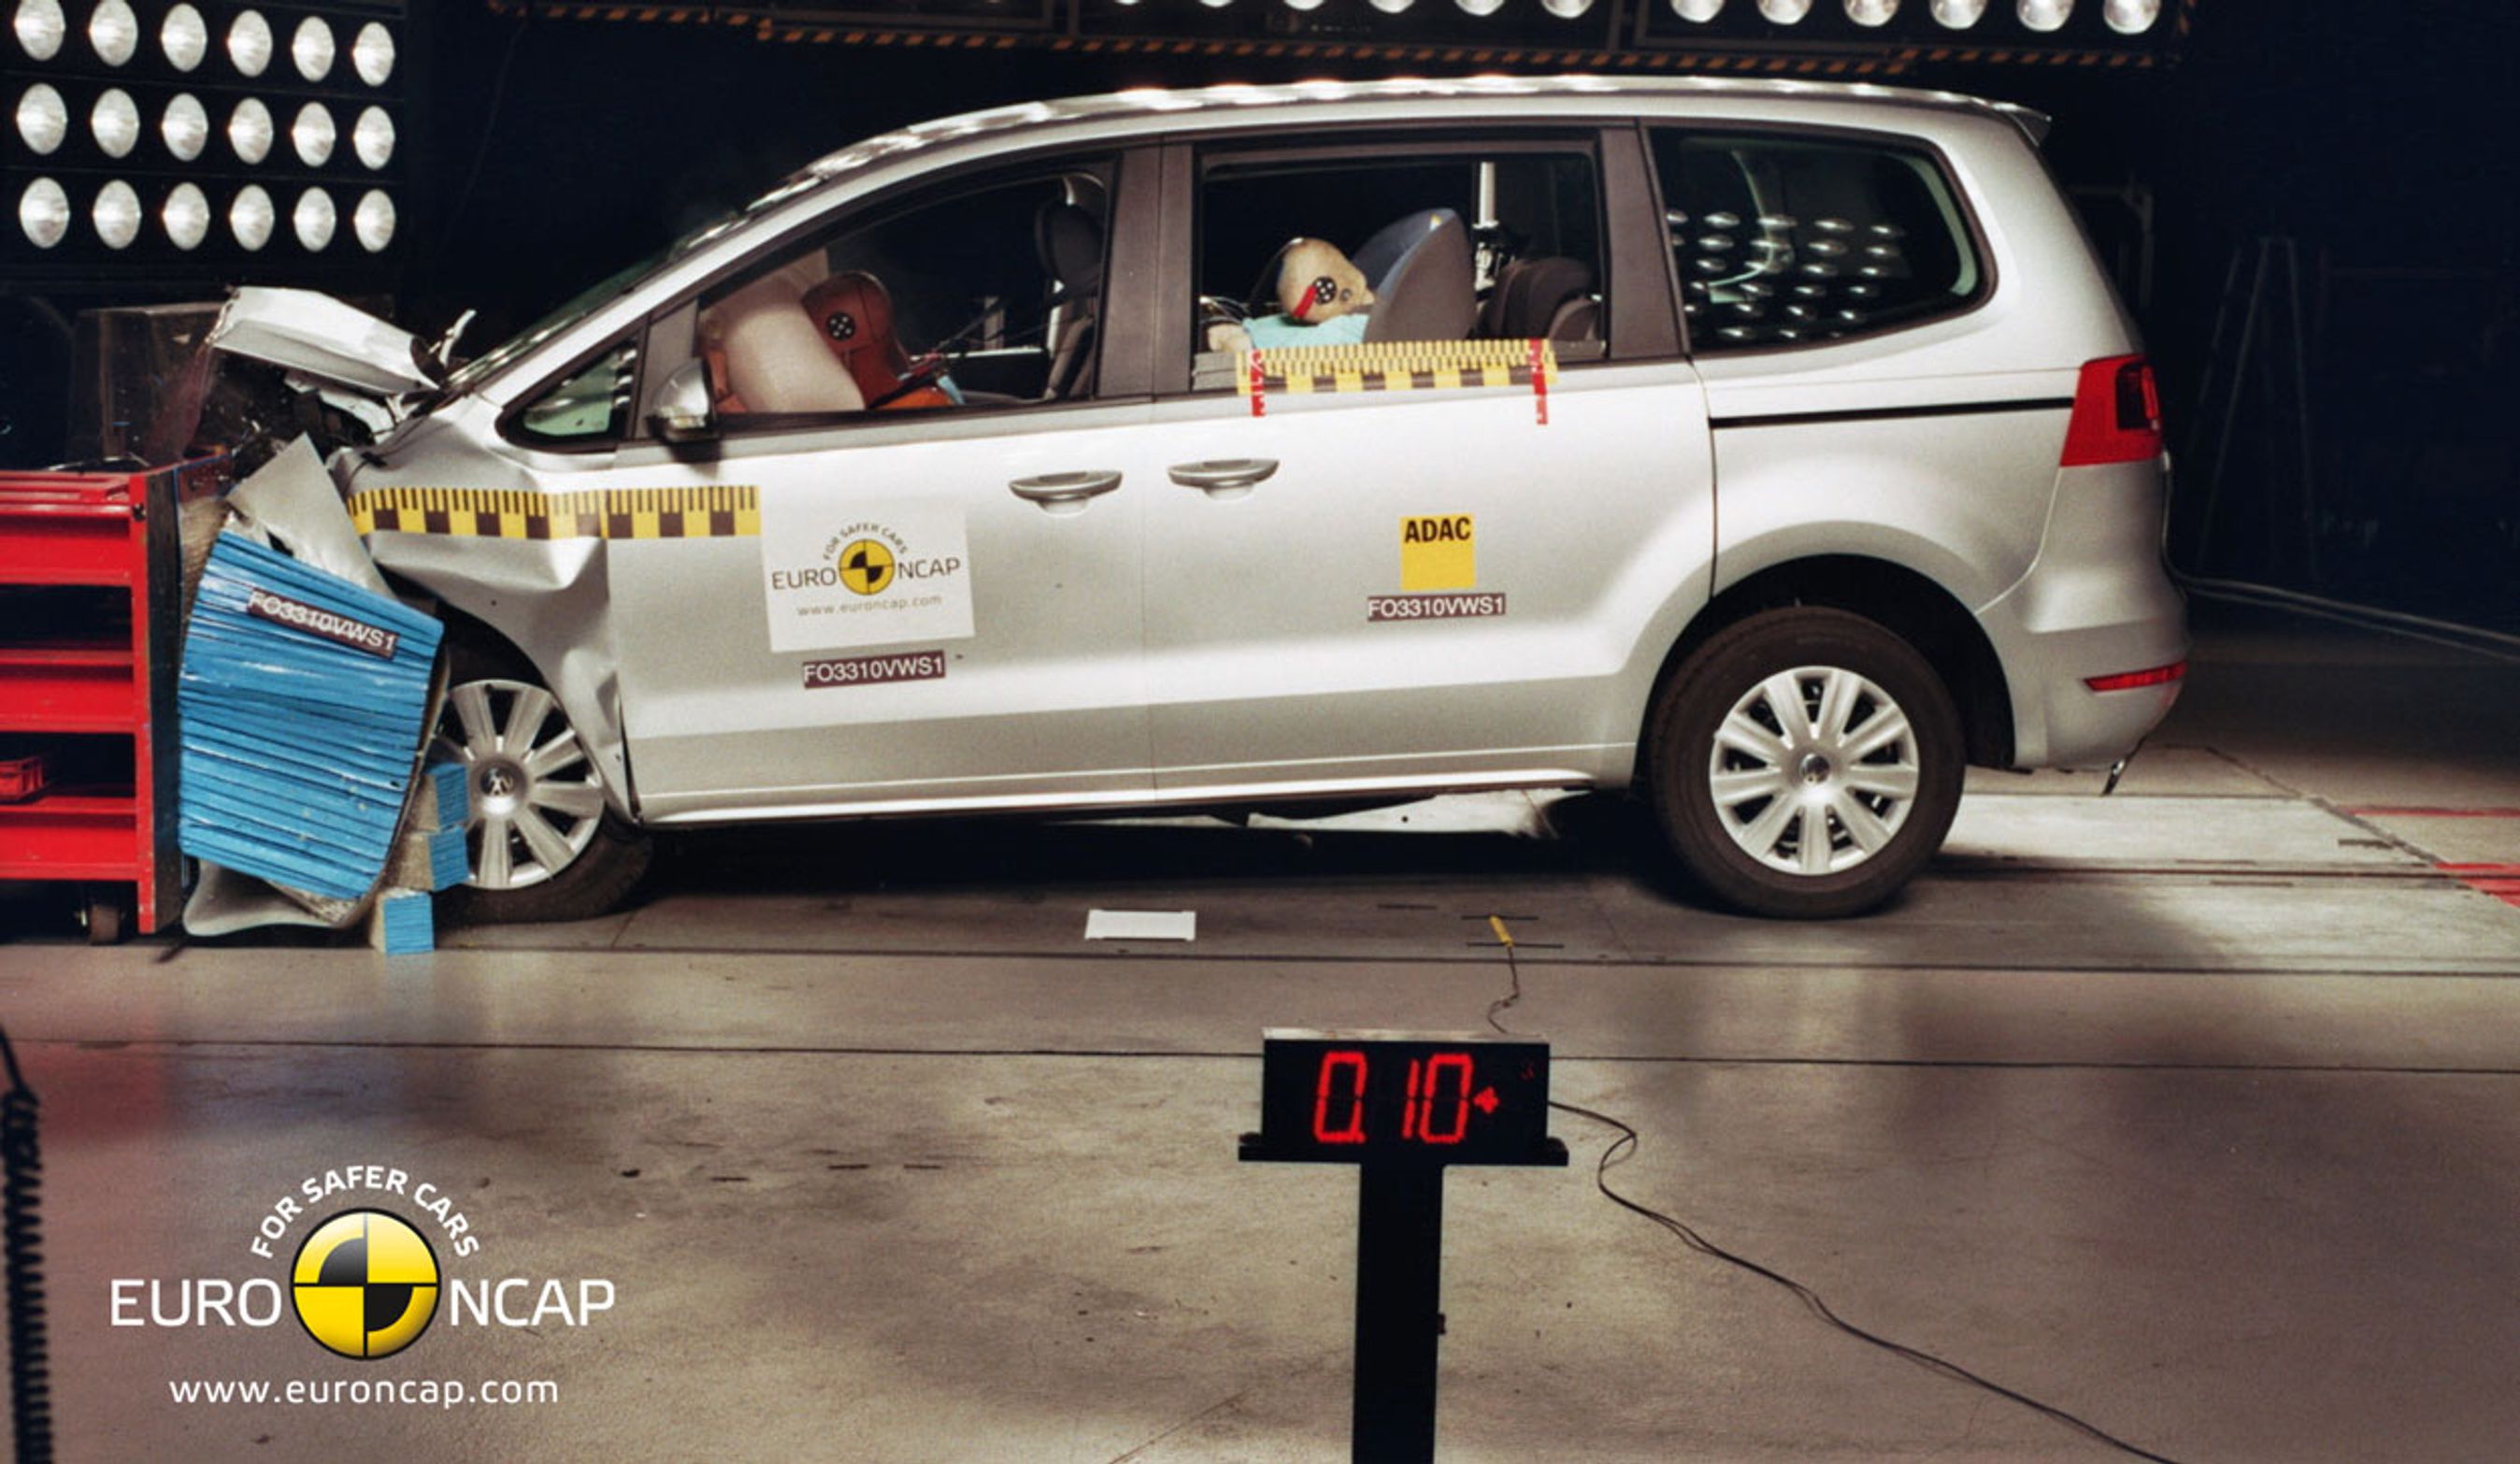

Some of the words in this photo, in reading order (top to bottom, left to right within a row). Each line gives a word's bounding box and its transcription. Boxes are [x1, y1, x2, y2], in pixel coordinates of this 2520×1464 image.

[823, 538, 839, 560] FOR
[839, 524, 879, 538] SAFER
[881, 527, 908, 553] CARS
[1404, 516, 1471, 543] ADAC
[771, 567, 838, 590] EURO
[898, 557, 961, 580] NCAP
[796, 595, 943, 616] www.euroncap.com
[1368, 596, 1503, 618] FO3310VWS1
[249, 590, 396, 651] FO3310VWS1
[803, 656, 944, 683] FO3310VWS1
